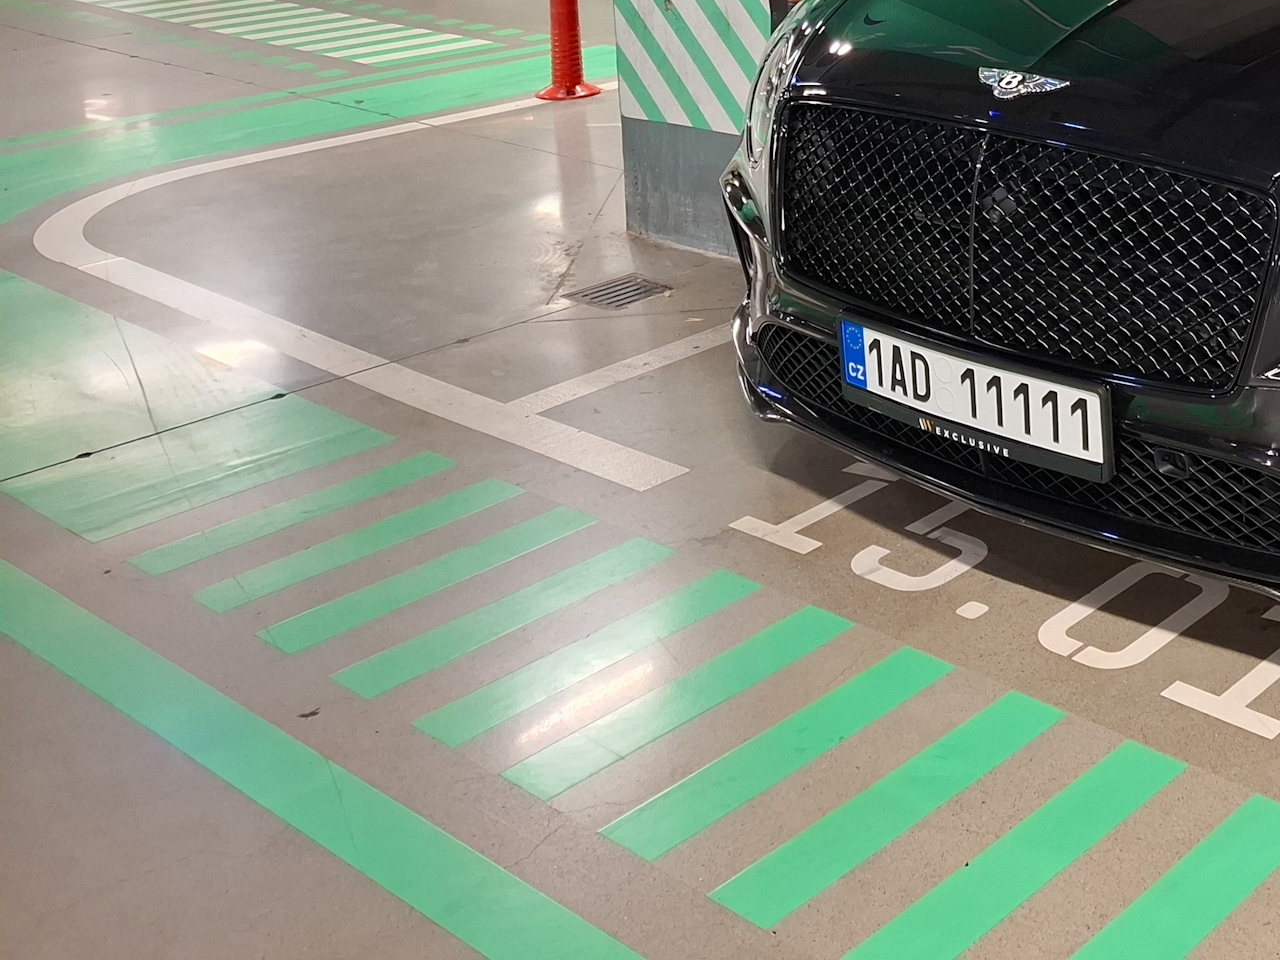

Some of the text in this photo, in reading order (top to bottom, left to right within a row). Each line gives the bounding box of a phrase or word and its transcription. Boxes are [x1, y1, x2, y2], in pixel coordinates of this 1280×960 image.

[848, 361, 865, 381] CZ
[868, 338, 1090, 452] 1AD 11111
[935, 426, 1009, 457] EXCLUSIVE
